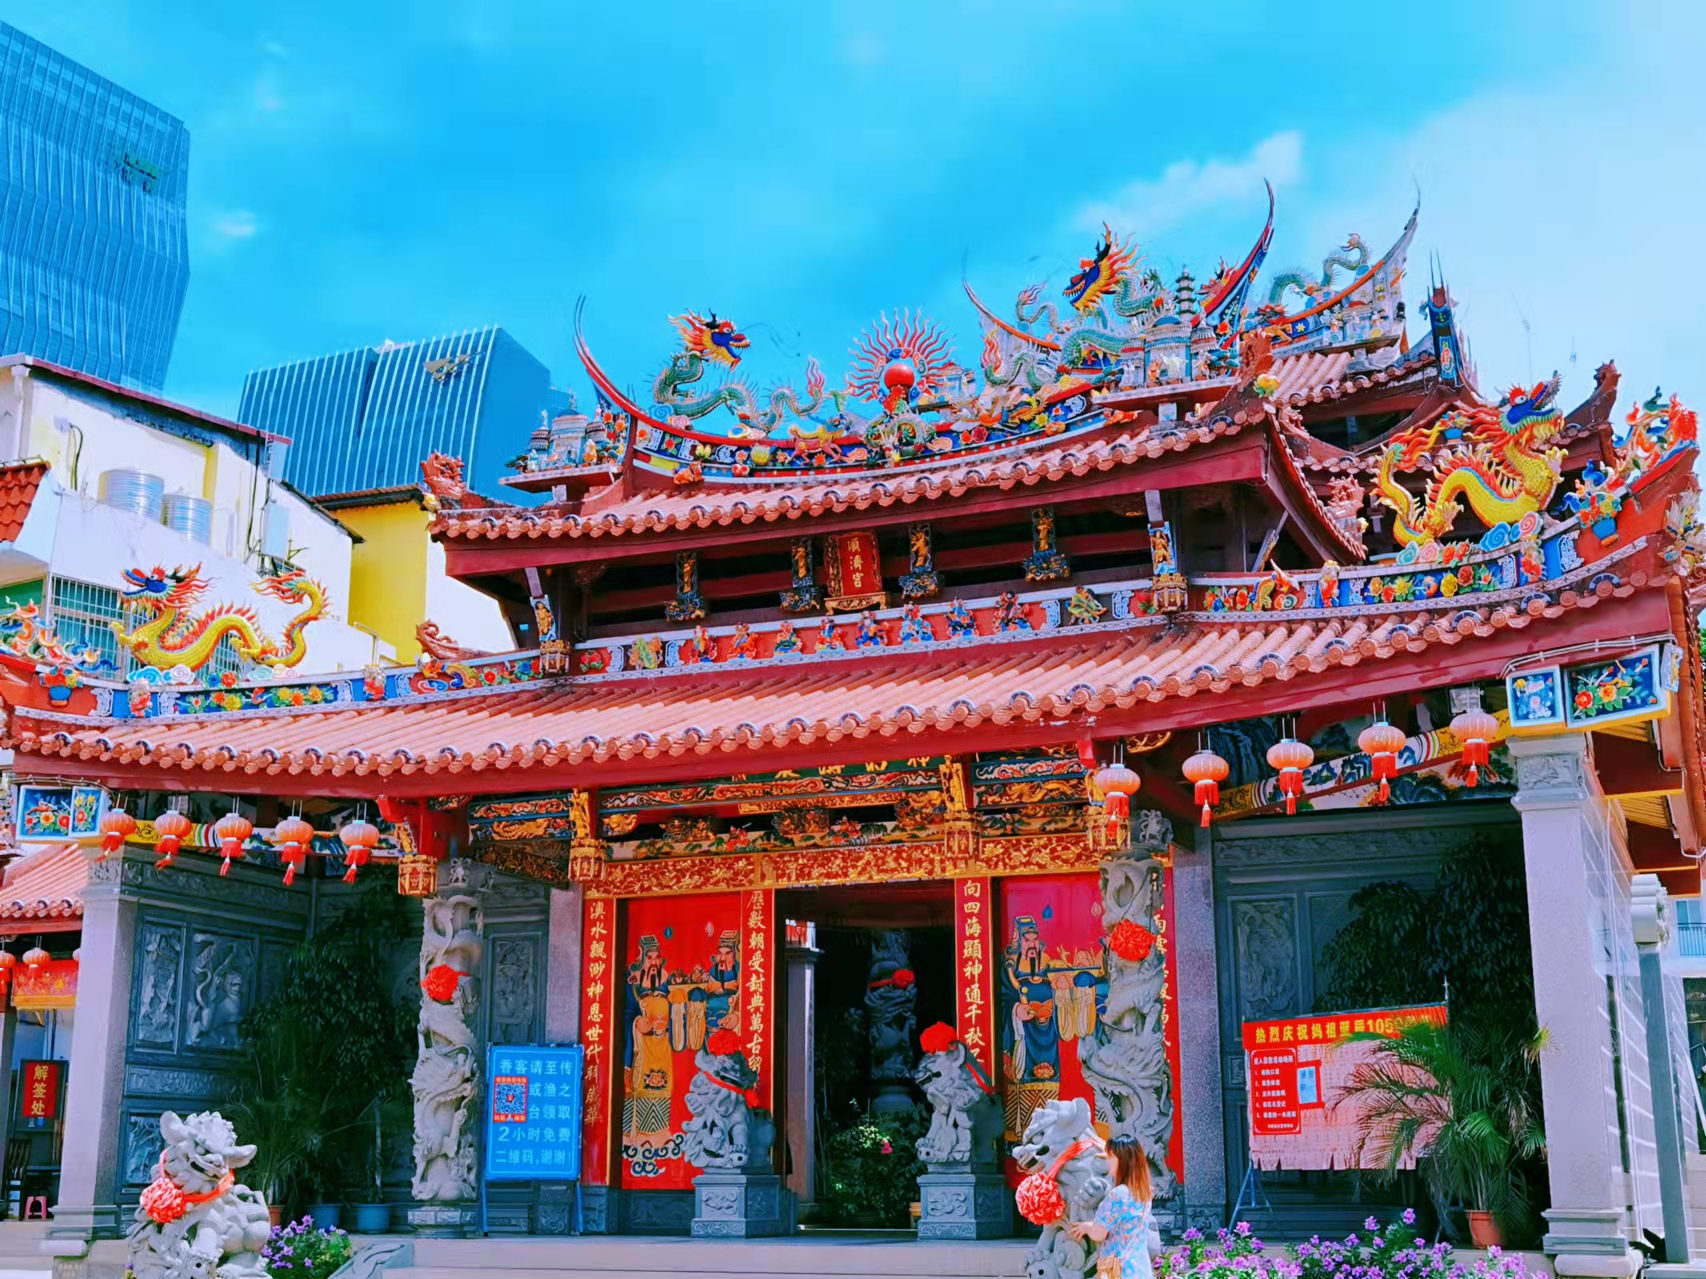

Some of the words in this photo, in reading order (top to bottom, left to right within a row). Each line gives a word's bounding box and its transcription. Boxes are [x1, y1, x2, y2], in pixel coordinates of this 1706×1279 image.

[746, 890, 767, 1090] 歷數朝受封典萬古留
[500, 1059, 573, 1075] 香客请至传
[31, 1064, 49, 1116] 解签处
[529, 1104, 571, 1119] 台领取
[498, 1126, 571, 1142] 2小时免费
